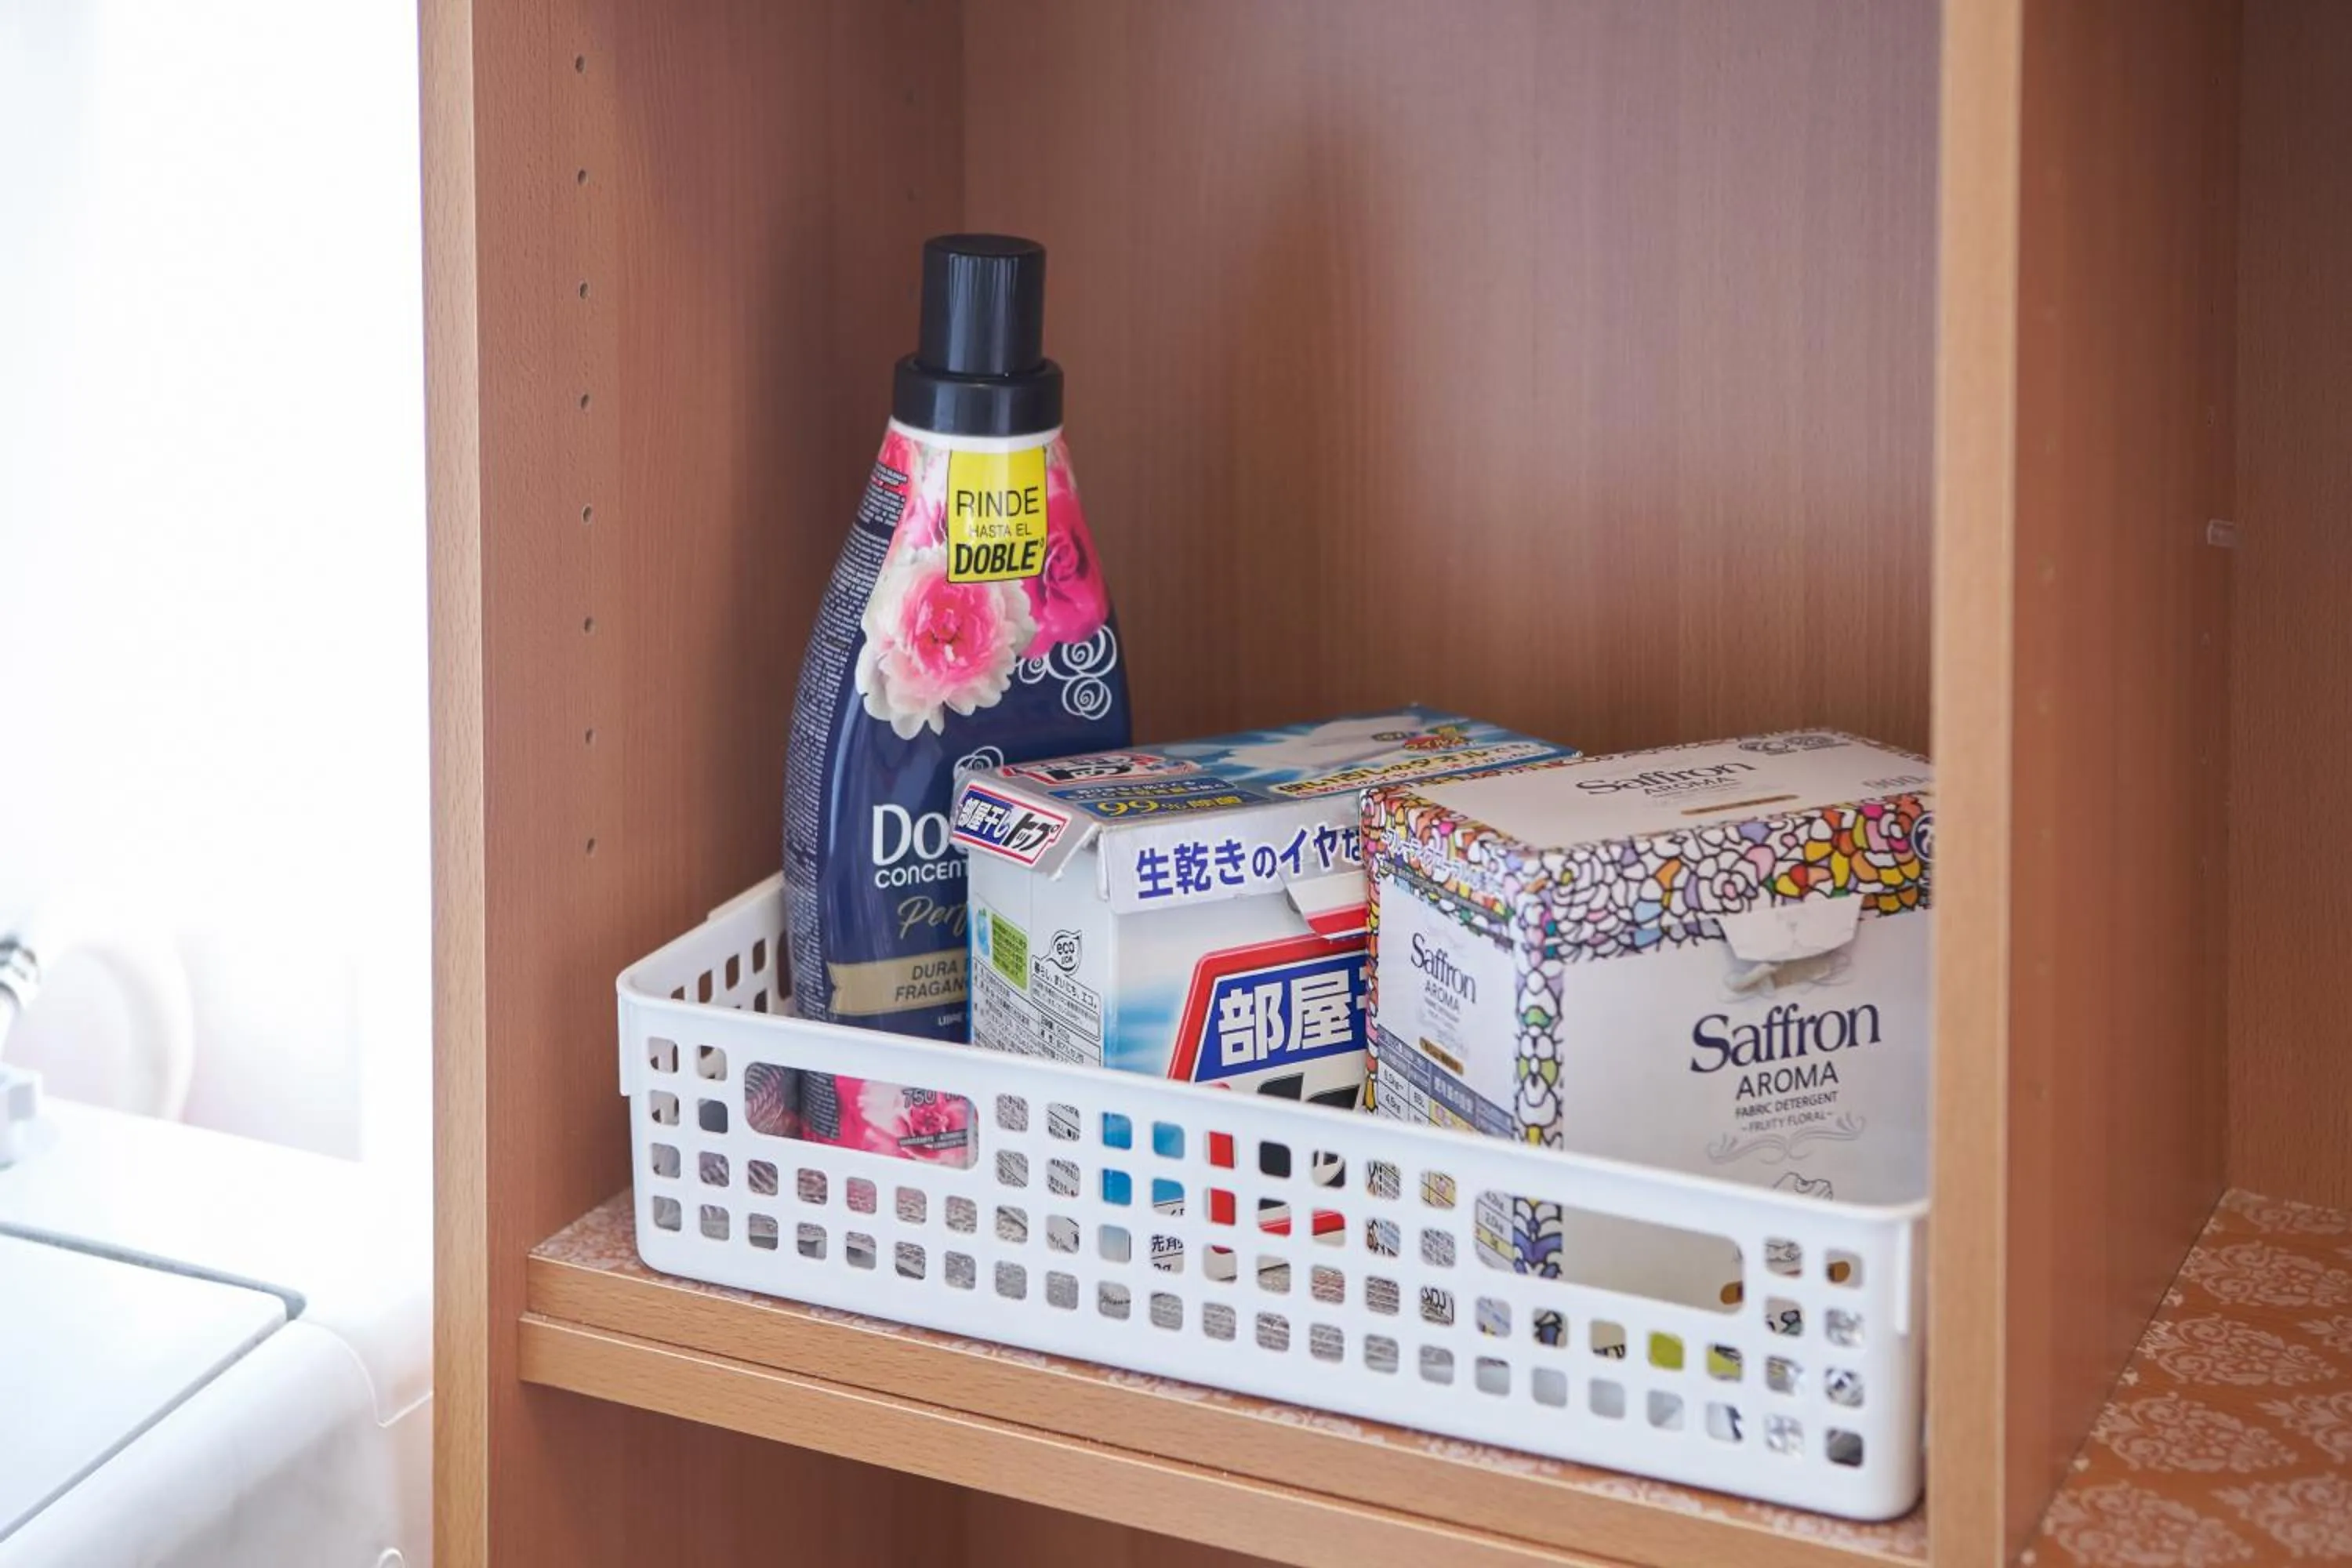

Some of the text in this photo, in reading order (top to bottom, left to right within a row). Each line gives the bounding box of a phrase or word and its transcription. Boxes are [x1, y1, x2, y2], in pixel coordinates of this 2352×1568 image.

[956, 485, 1040, 517] RINDE
[969, 523, 1033, 539] HASTA EL
[954, 539, 1040, 575] DOBLE
[1576, 762, 1757, 795] Saffron
[1643, 777, 1737, 797] AROMA
[873, 804, 969, 866] Do
[912, 960, 958, 980] DURA
[1411, 932, 1476, 1004] Saffron
[895, 977, 968, 1002] FRAGAN
[1425, 980, 1461, 1011] AROMA
[1217, 967, 1367, 1067] 部屋
[1690, 1003, 1882, 1073] Saffron
[1735, 1061, 1839, 1101] AROMA
[1735, 1091, 1839, 1120] FABRIC DETERGENT
